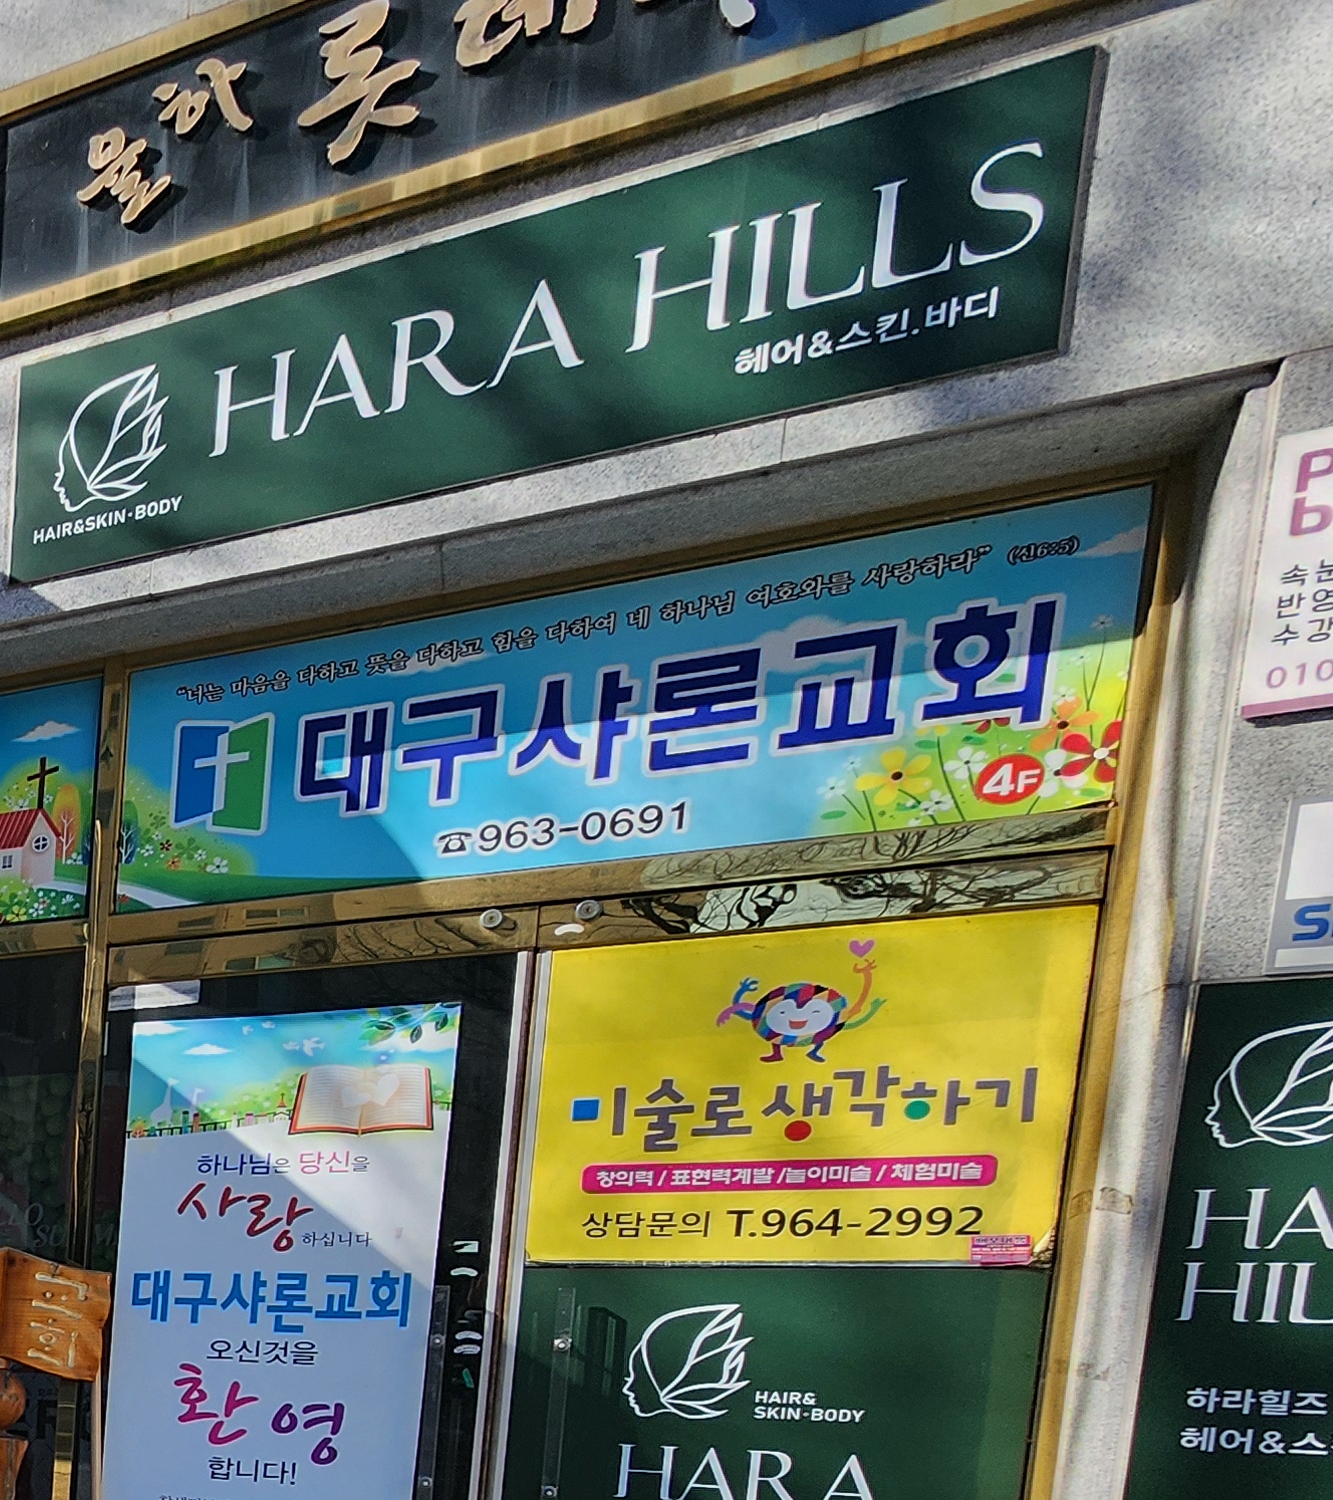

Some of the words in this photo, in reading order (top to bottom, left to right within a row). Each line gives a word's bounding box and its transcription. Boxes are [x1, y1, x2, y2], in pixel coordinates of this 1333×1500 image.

[208, 278, 585, 458] HARA
[624, 141, 1046, 354] HILLS
[231, 670, 289, 695] 마음을
[297, 659, 358, 686] 다하고
[366, 651, 409, 675] 뜻을
[416, 638, 482, 665] 다하고
[493, 627, 537, 654] 힘을
[545, 612, 616, 641] 다하여
[627, 607, 650, 628] 네
[661, 591, 736, 622] 하나님
[746, 573, 854, 607] 여호와를
[477, 800, 689, 853] 963-0691
[979, 760, 1041, 798] 4F
[596, 1167, 654, 1187] 창의력
[889, 1161, 984, 1182] 체험미술
[176, 1181, 314, 1253] 사랑
[301, 1230, 373, 1249] 하십니다
[581, 1210, 711, 1239] 상담문의
[130, 1269, 413, 1334] 대구샤론교회
[205, 1339, 320, 1367] 오신것을
[754, 1390, 818, 1407] HAIR&
[1186, 1385, 1329, 1417] 하라힐즈
[1179, 1424, 1333, 1456] 헤어&스
[207, 1456, 298, 1486] 합니다!
